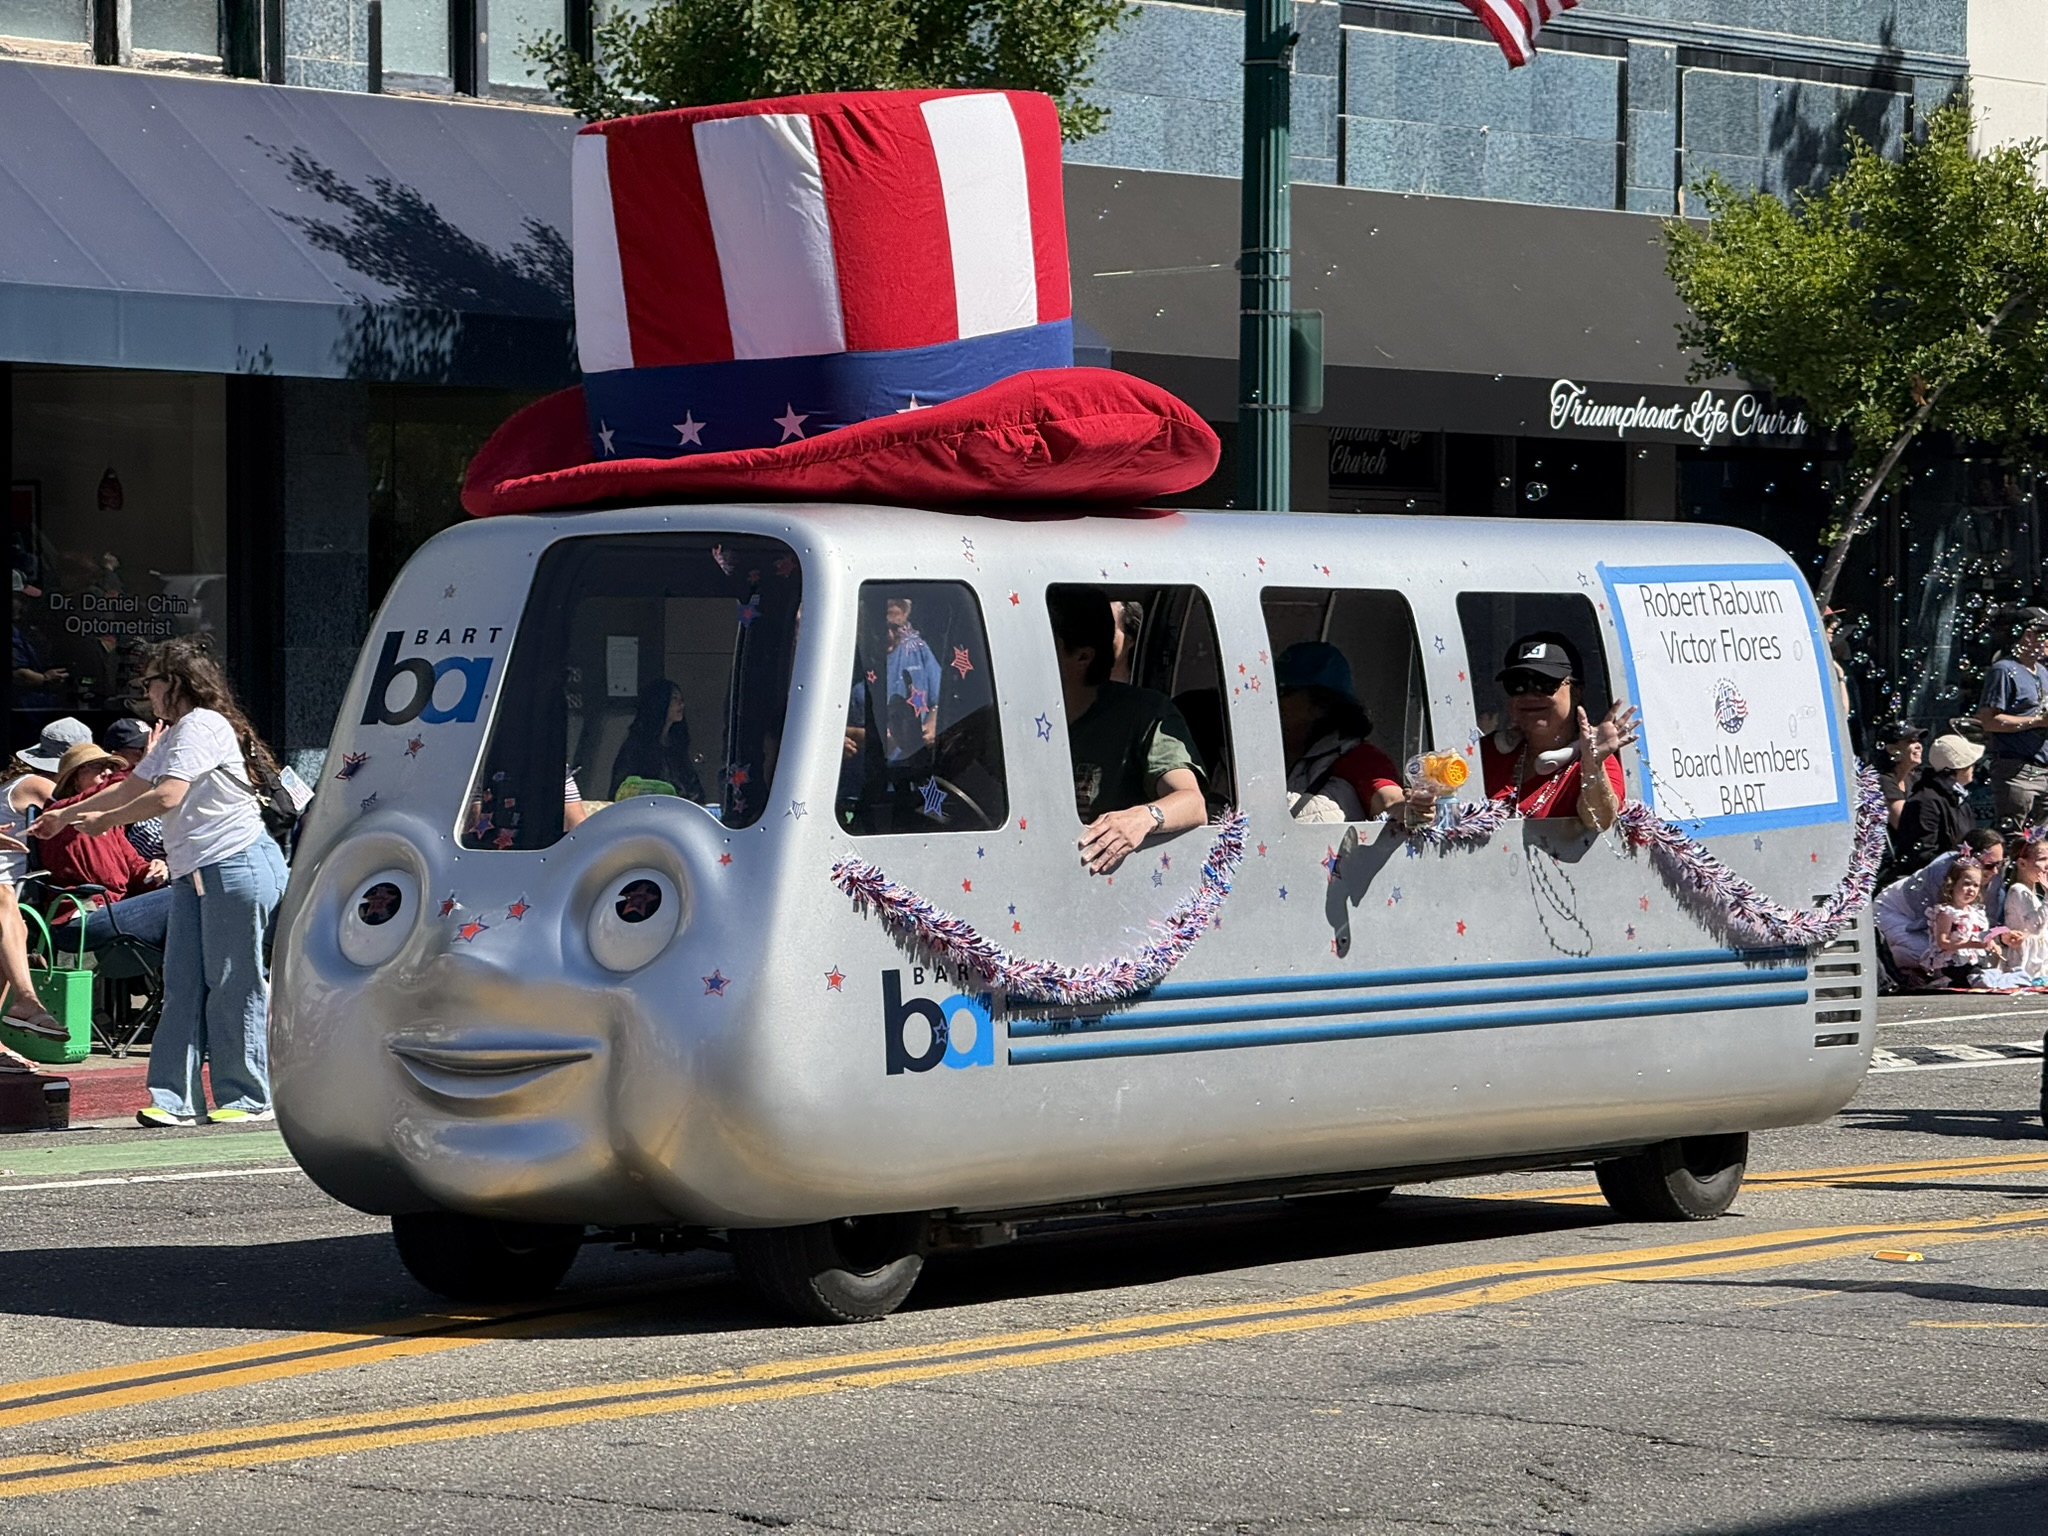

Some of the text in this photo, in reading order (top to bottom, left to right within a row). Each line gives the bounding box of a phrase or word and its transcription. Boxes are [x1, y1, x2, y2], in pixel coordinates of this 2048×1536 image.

[1550, 379, 1808, 445] Triumphant Life Church
[1331, 445, 1387, 474] Church
[50, 593, 188, 613] Dr. Daniel Chin
[1639, 581, 1783, 617] Robert Raburn
[65, 616, 171, 636] Optometrist
[414, 627, 502, 645] BART
[1660, 627, 1781, 664] Victor Flores
[360, 631, 494, 726] ba
[1672, 741, 1810, 778] Board Members
[1719, 783, 1766, 815] BART
[913, 963, 969, 985] BAR
